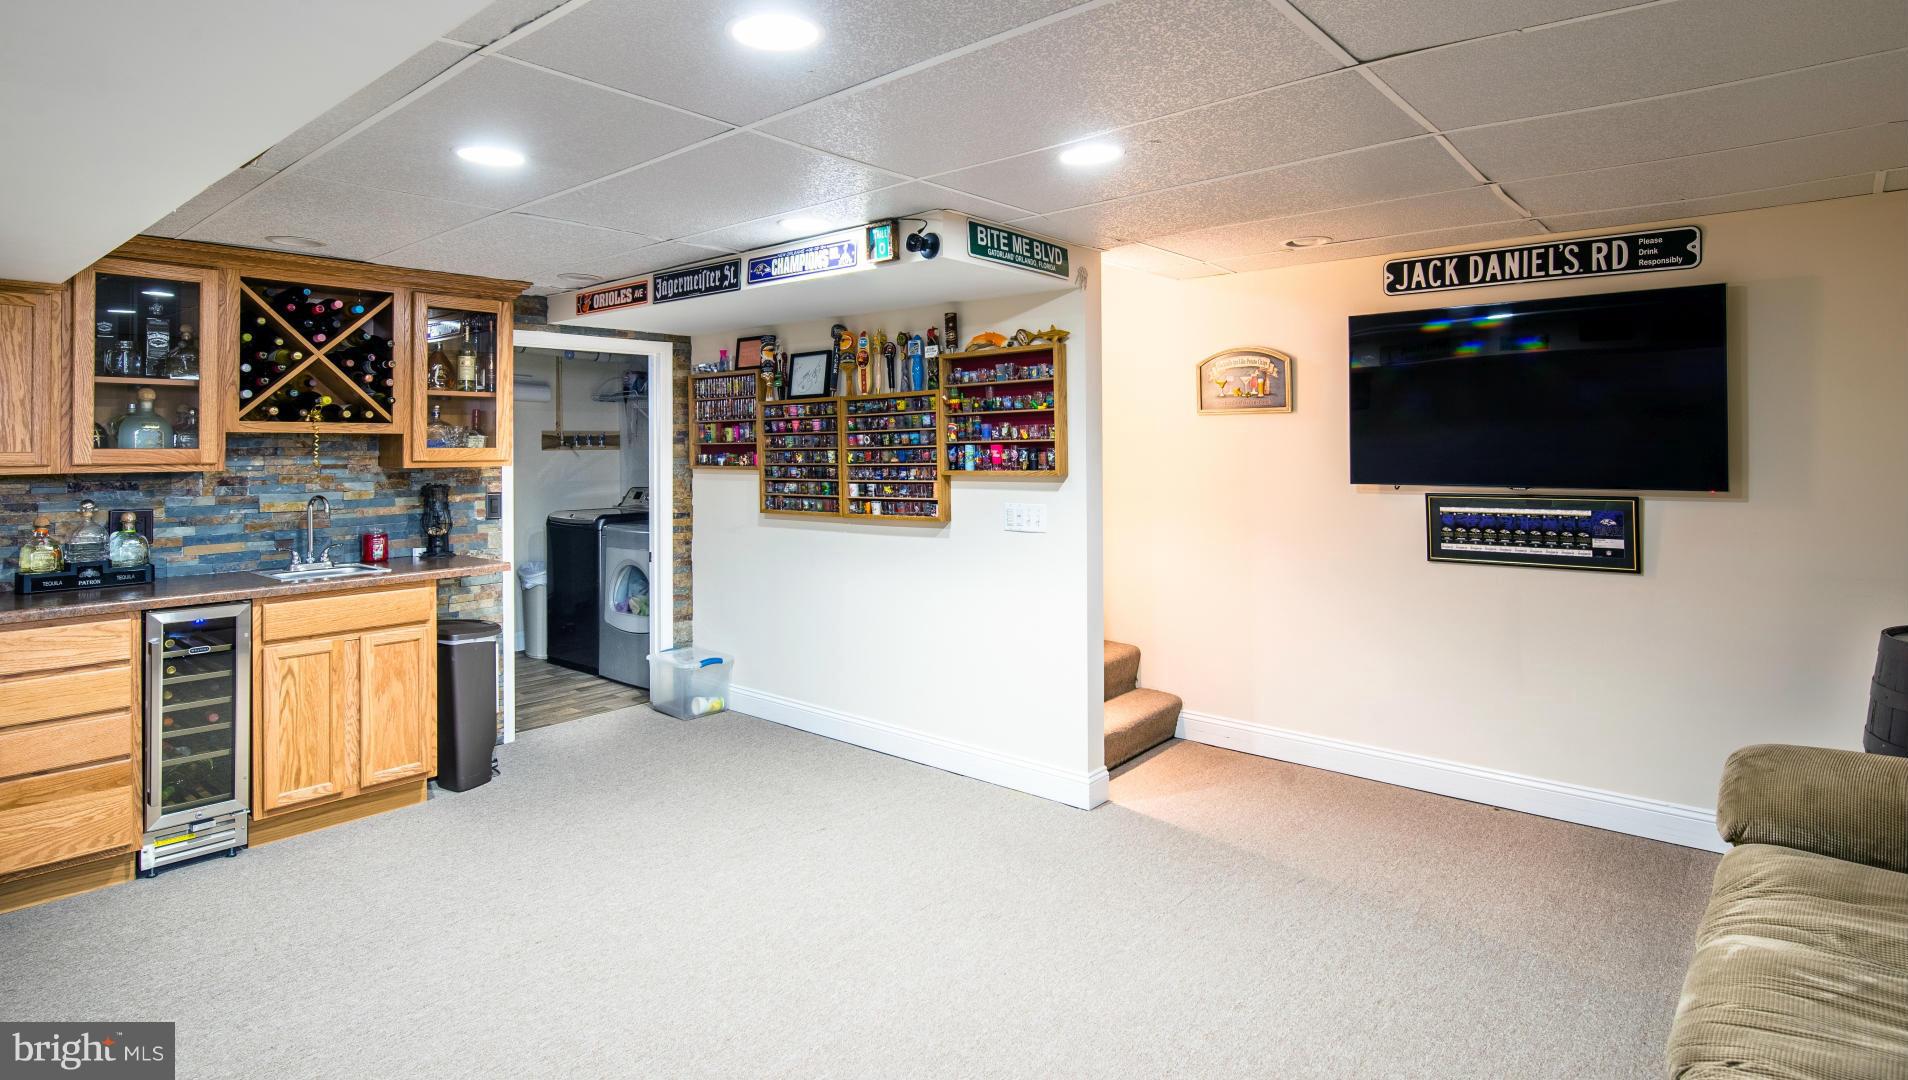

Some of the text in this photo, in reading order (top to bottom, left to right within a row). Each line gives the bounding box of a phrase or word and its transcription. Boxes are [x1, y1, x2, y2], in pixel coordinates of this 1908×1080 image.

[977, 225, 1062, 265] BITE ME BLVD
[1638, 236, 1663, 245] Please
[1638, 247, 1658, 256] Drink
[771, 248, 829, 276] CHAMPIONS
[1395, 258, 1459, 290] JACK
[1592, 239, 1629, 272] RD
[1638, 255, 1683, 267] Responsibly
[722, 265, 737, 288] St.
[593, 288, 633, 309] ORIOLES
